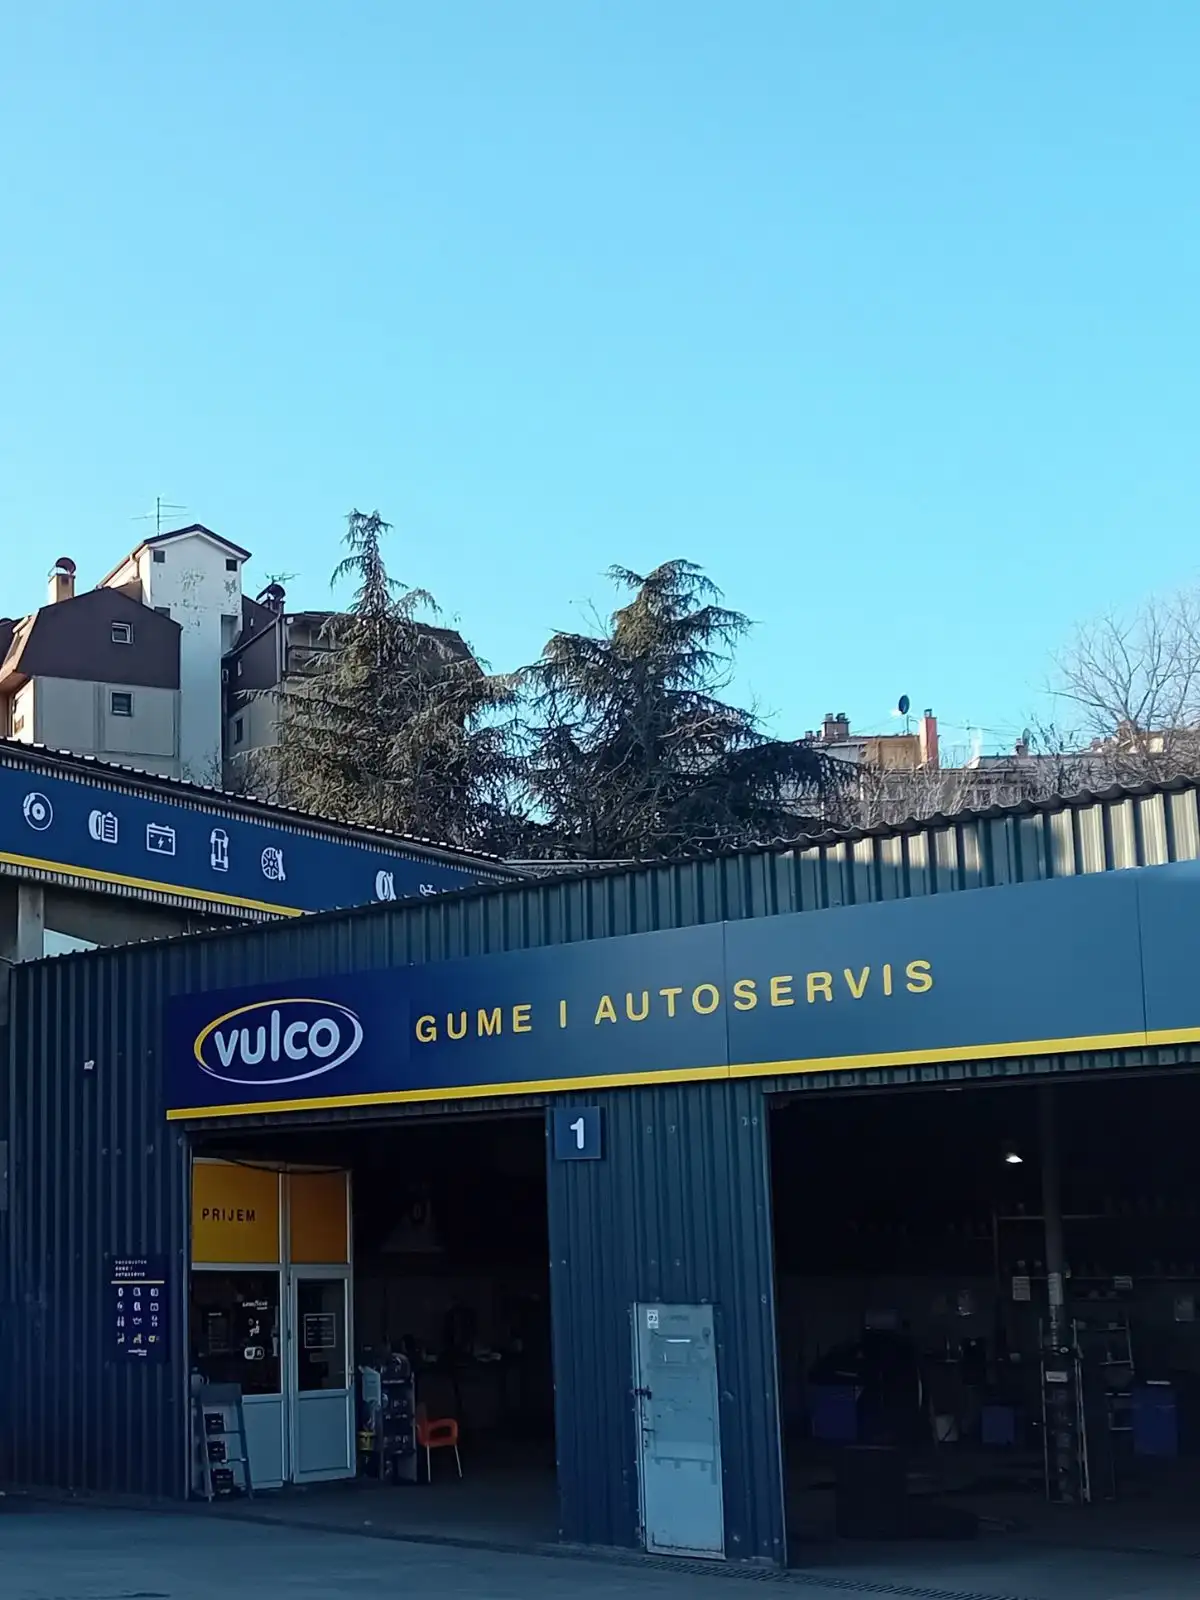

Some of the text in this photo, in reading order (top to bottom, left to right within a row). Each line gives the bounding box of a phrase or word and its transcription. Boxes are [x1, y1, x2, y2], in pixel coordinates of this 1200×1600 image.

[415, 959, 934, 1043] GUME I AUTOSERVIS
[214, 1009, 341, 1068] vulco
[570, 1117, 585, 1150] 1
[202, 1207, 256, 1222] PRIJEM
